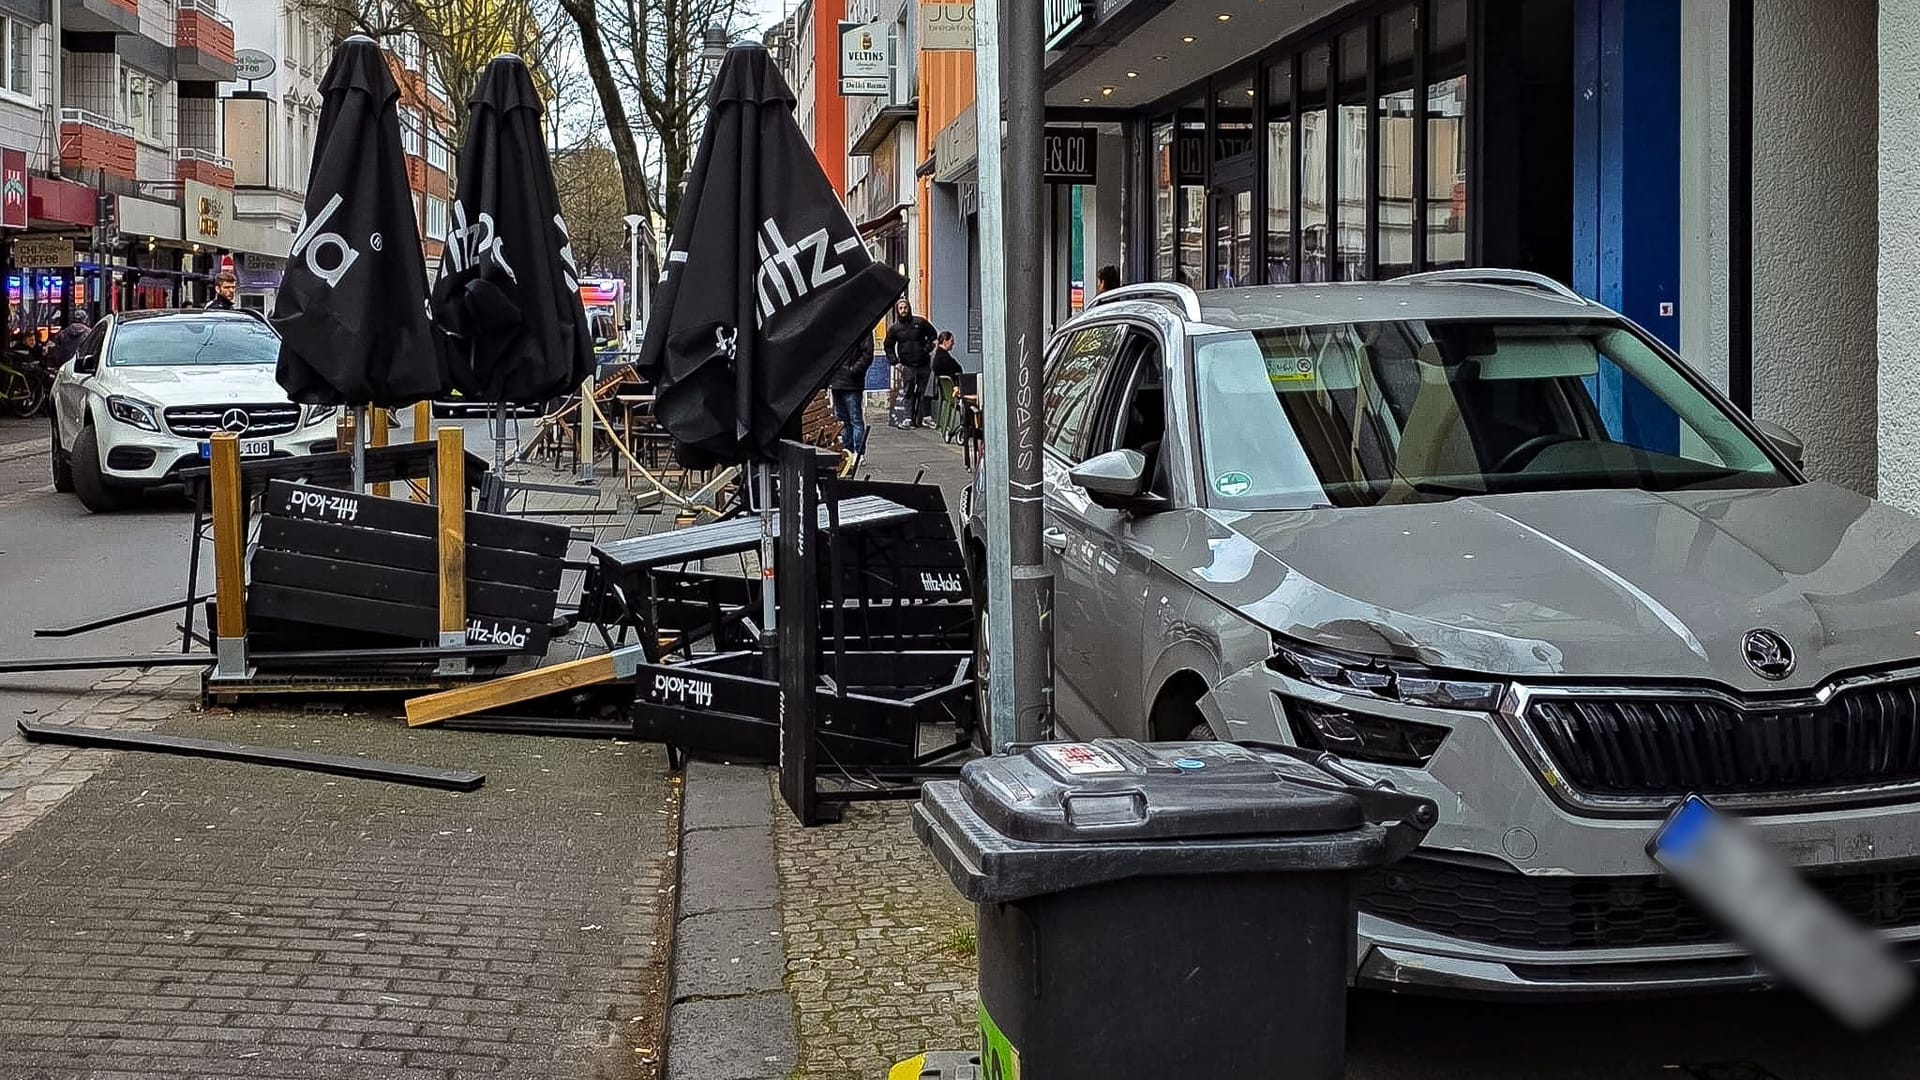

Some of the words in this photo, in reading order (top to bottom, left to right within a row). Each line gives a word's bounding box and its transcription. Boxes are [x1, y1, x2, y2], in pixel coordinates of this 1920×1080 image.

[848, 51, 884, 61] VELTINS
[246, 442, 268, 454] 108
[290, 490, 359, 521] fritz-kola
[465, 618, 526, 647] ritz-kola
[655, 674, 713, 706] fritz-kola
